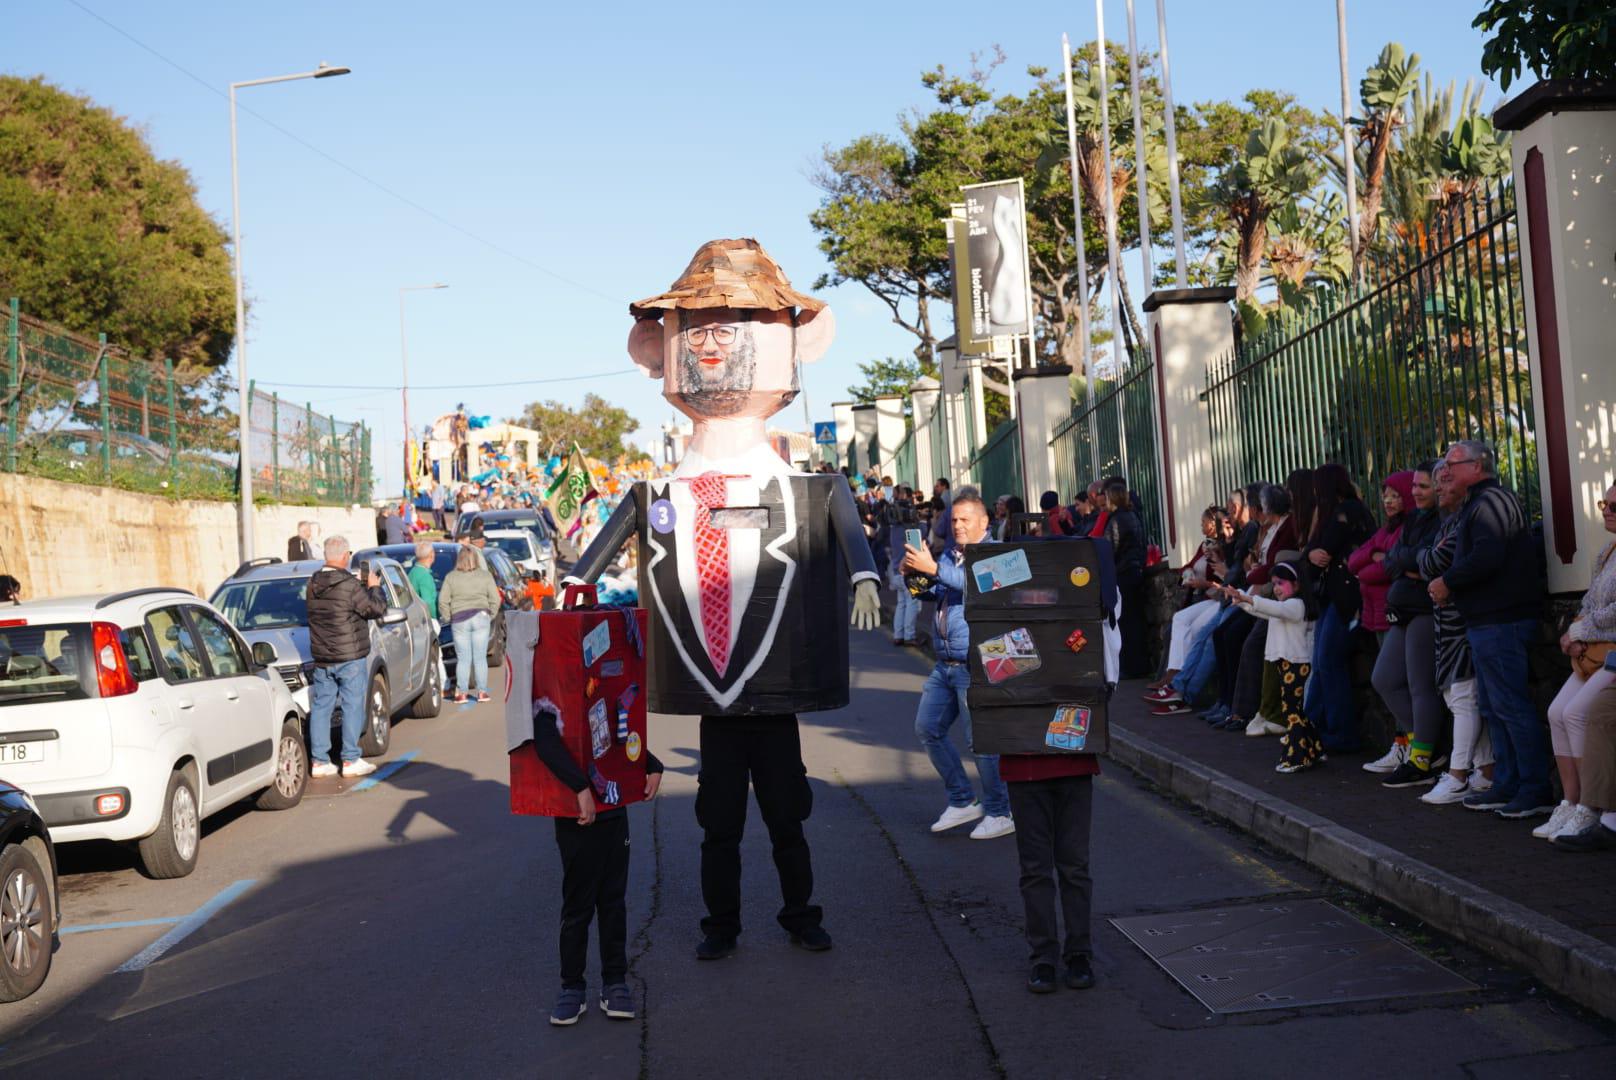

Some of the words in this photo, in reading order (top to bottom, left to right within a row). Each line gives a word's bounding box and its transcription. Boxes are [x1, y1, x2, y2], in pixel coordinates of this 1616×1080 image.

[971, 268, 984, 335] bioformismo
[658, 506, 669, 525] 3
[0, 745, 8, 761] T
[11, 744, 26, 760] 18
